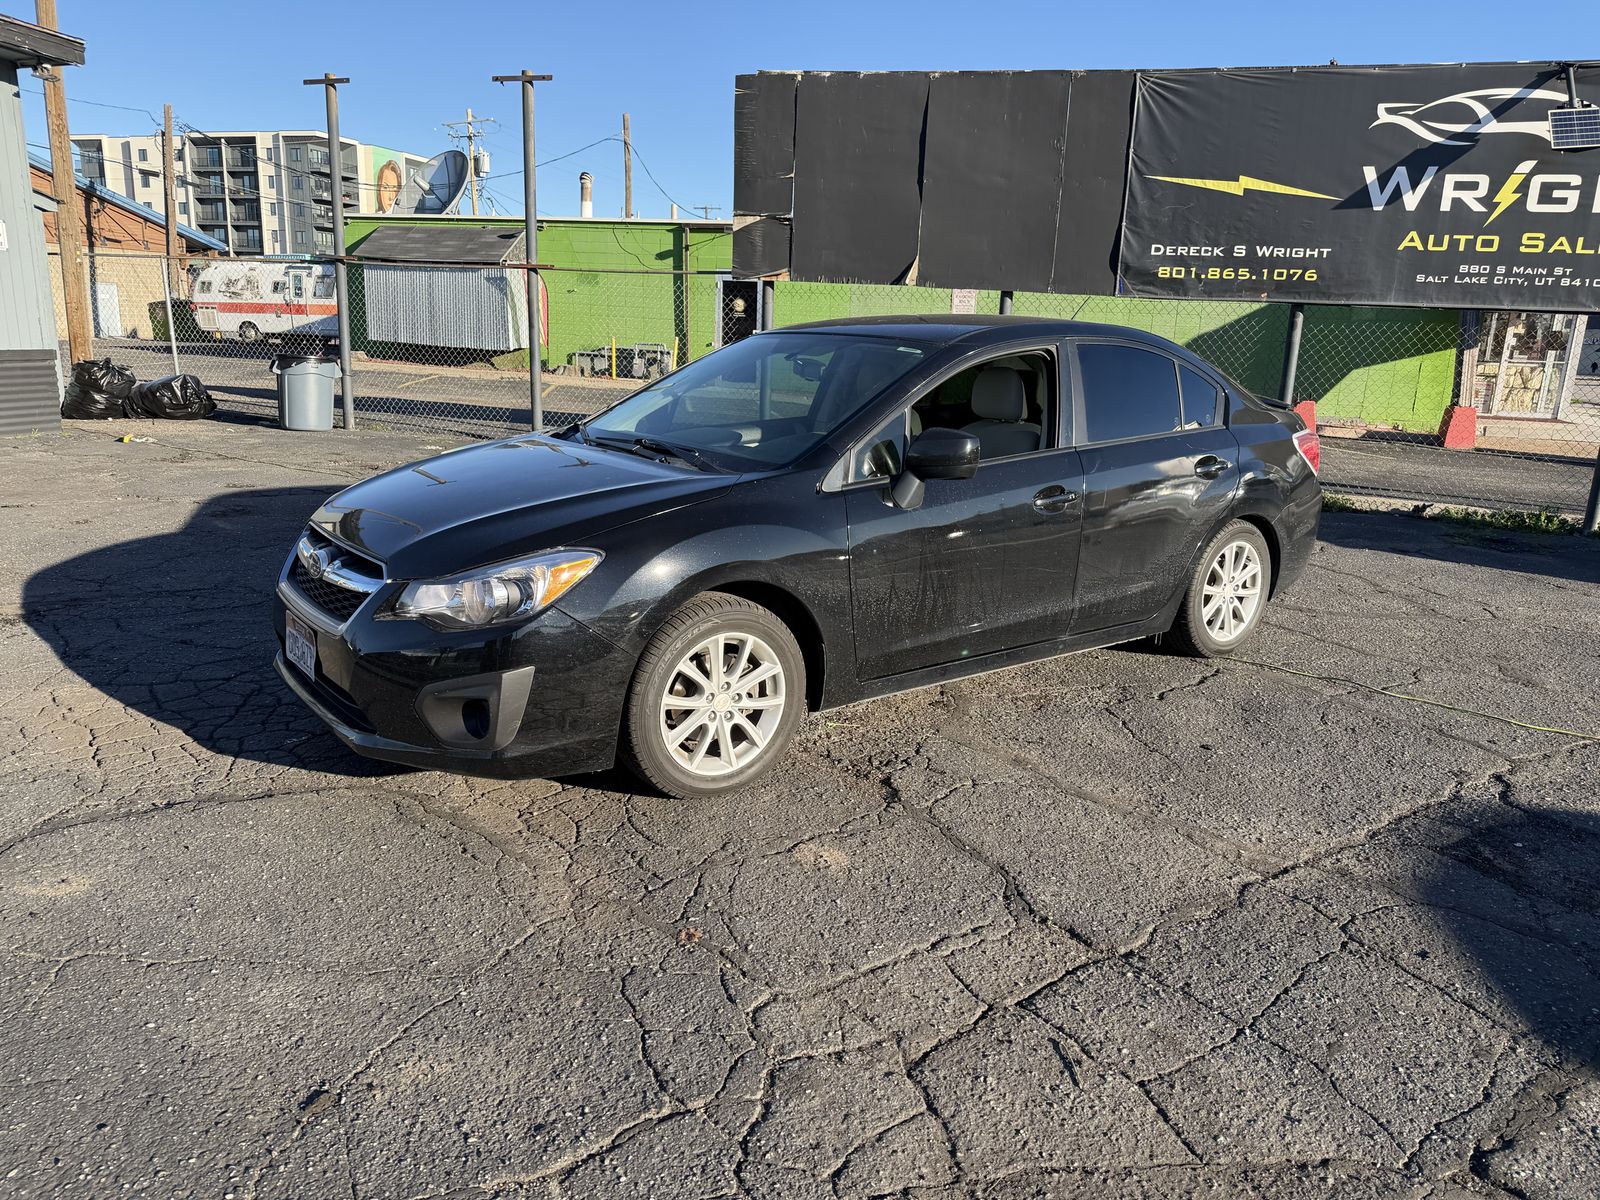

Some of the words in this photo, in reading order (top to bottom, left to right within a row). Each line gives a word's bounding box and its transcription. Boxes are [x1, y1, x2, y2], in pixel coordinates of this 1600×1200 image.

[1398, 230, 1500, 252] AUTO
[1519, 232, 1600, 254] SAL
[1150, 244, 1225, 257] DERECK
[1233, 245, 1247, 257] S
[1255, 245, 1332, 259] WRIGHT
[1157, 266, 1318, 281] 801.865.1076
[1459, 265, 1490, 274] 880
[1496, 265, 1506, 274] S
[1512, 266, 1547, 276] MAIN
[1553, 267, 1573, 276] ST
[1416, 275, 1448, 284] SALT
[1454, 276, 1488, 285] LAKE
[1493, 276, 1528, 287] CITY,
[1535, 277, 1555, 286] UT
